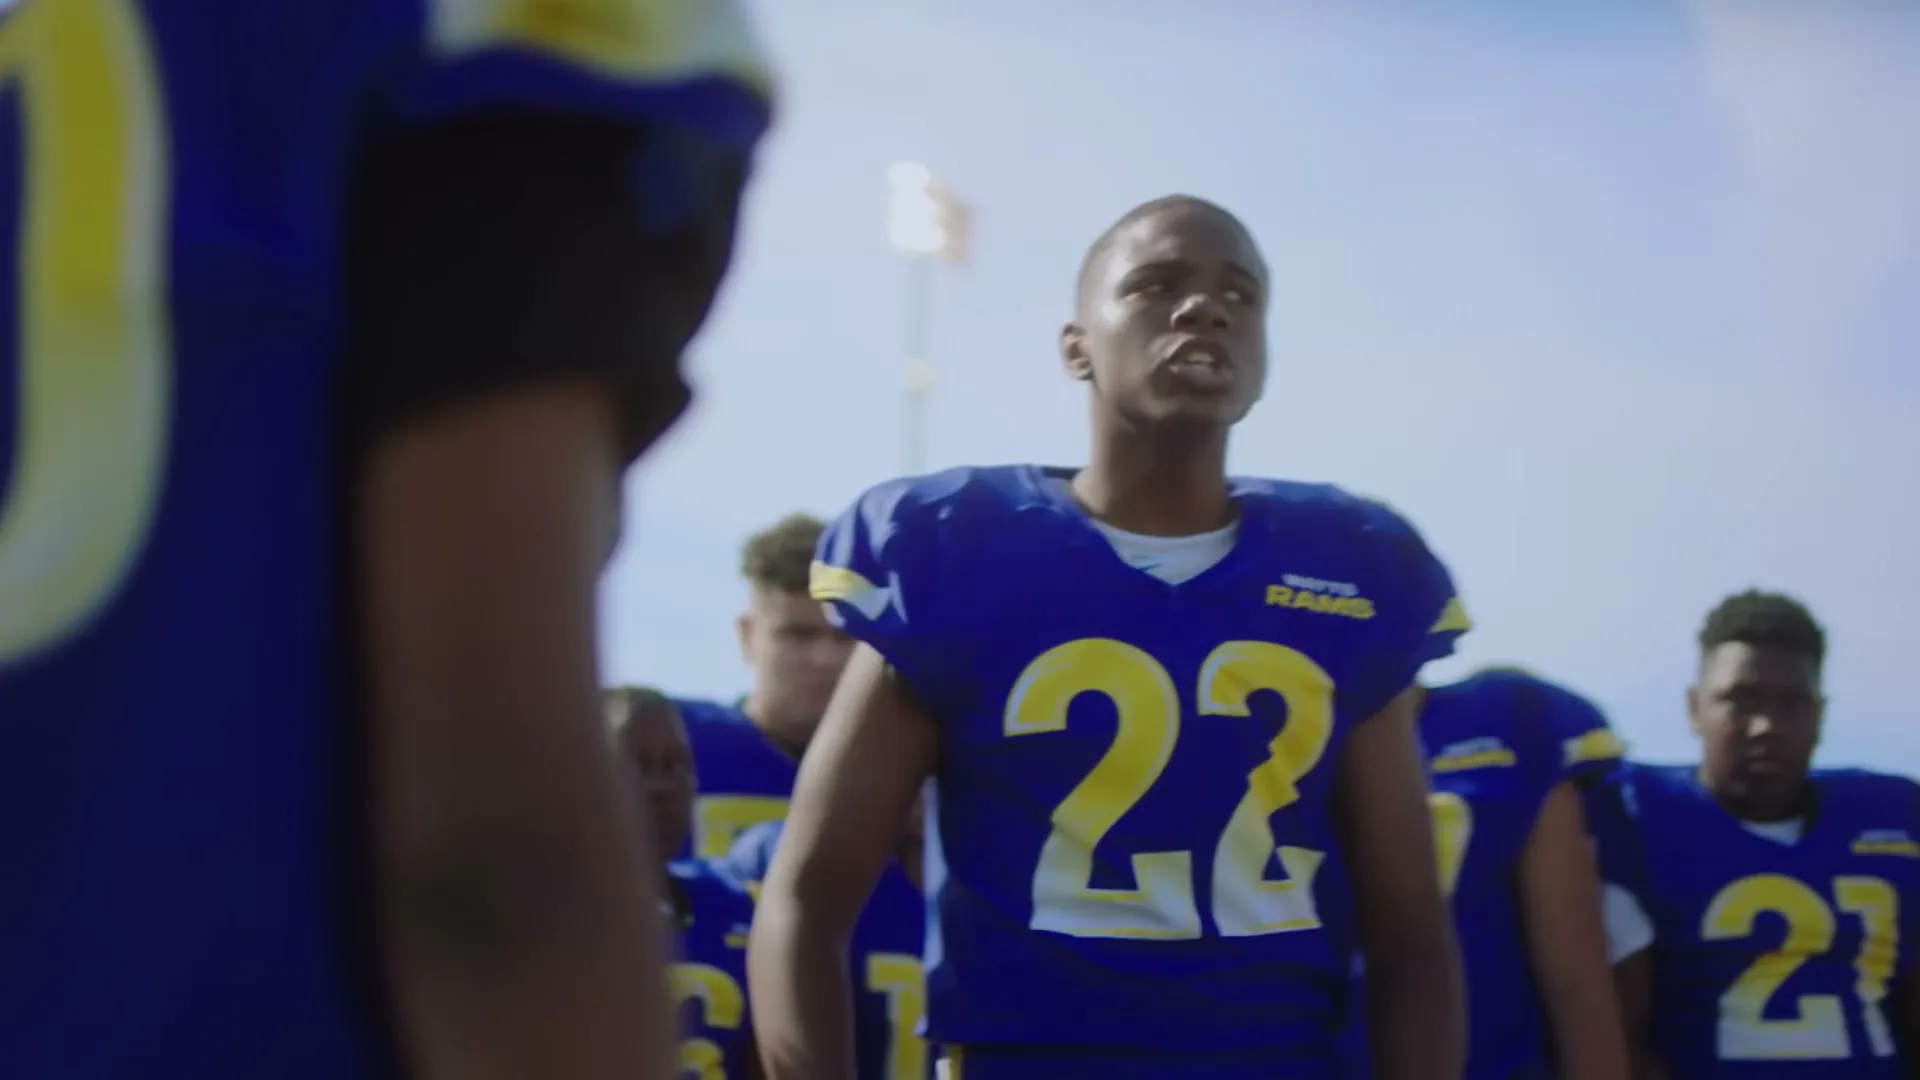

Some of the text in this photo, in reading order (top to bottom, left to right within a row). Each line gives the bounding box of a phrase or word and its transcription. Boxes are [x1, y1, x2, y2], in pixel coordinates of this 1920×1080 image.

[1264, 585, 1377, 619] RAMS
[1003, 637, 1335, 940] 22
[1702, 873, 1898, 1060] 21
